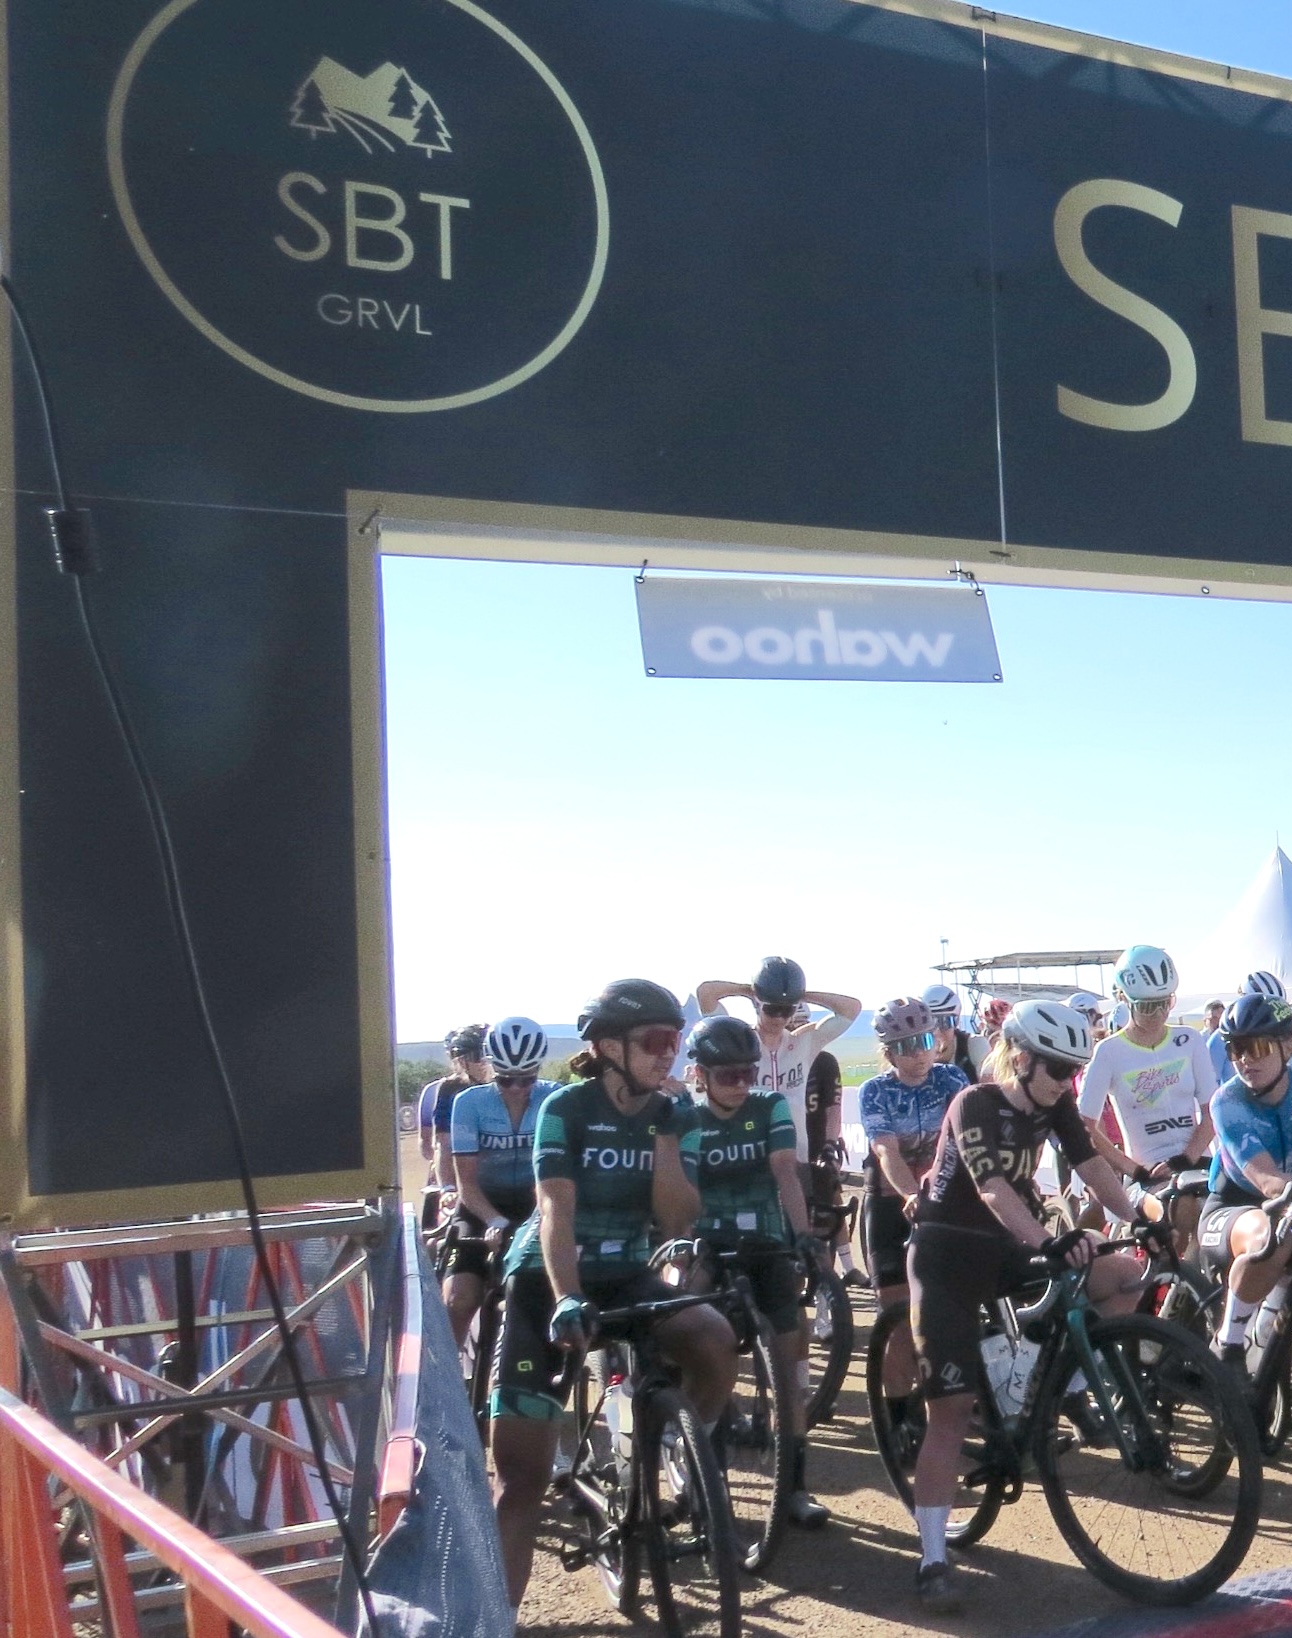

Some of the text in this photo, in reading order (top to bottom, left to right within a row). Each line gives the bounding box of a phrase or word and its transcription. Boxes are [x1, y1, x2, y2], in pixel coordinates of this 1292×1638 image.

[274, 171, 470, 280] SBT
[317, 293, 433, 336] GRVL
[582, 1148, 654, 1171] FOUN
[701, 1141, 766, 1166] OUNT
